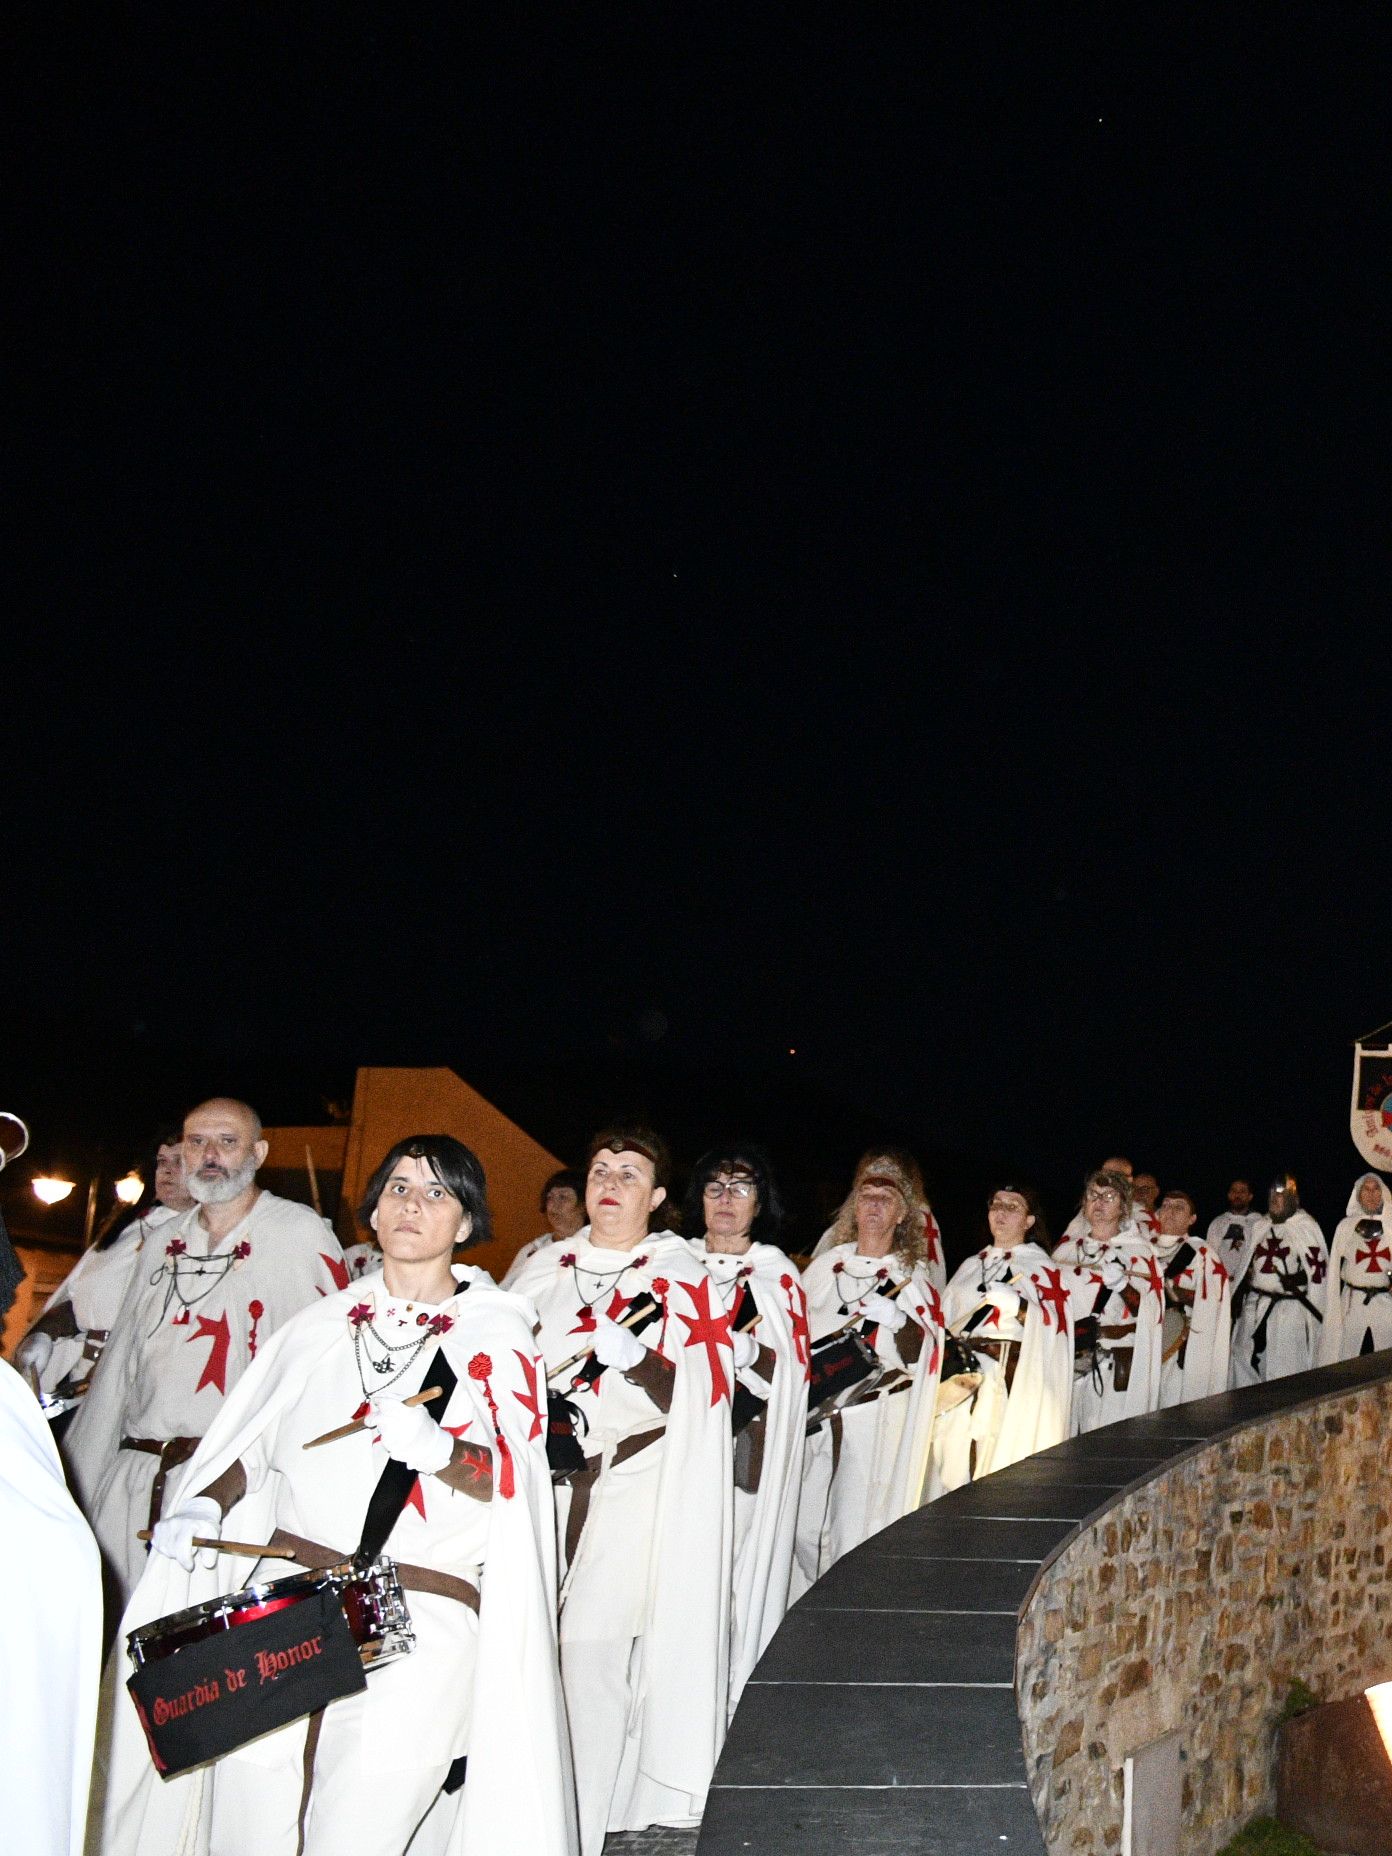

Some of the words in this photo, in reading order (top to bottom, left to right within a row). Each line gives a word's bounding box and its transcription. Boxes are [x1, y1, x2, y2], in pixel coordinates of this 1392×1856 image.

[153, 1677, 219, 1726] Guardia
[224, 1668, 247, 1692] de
[254, 1636, 322, 1685] Honor
